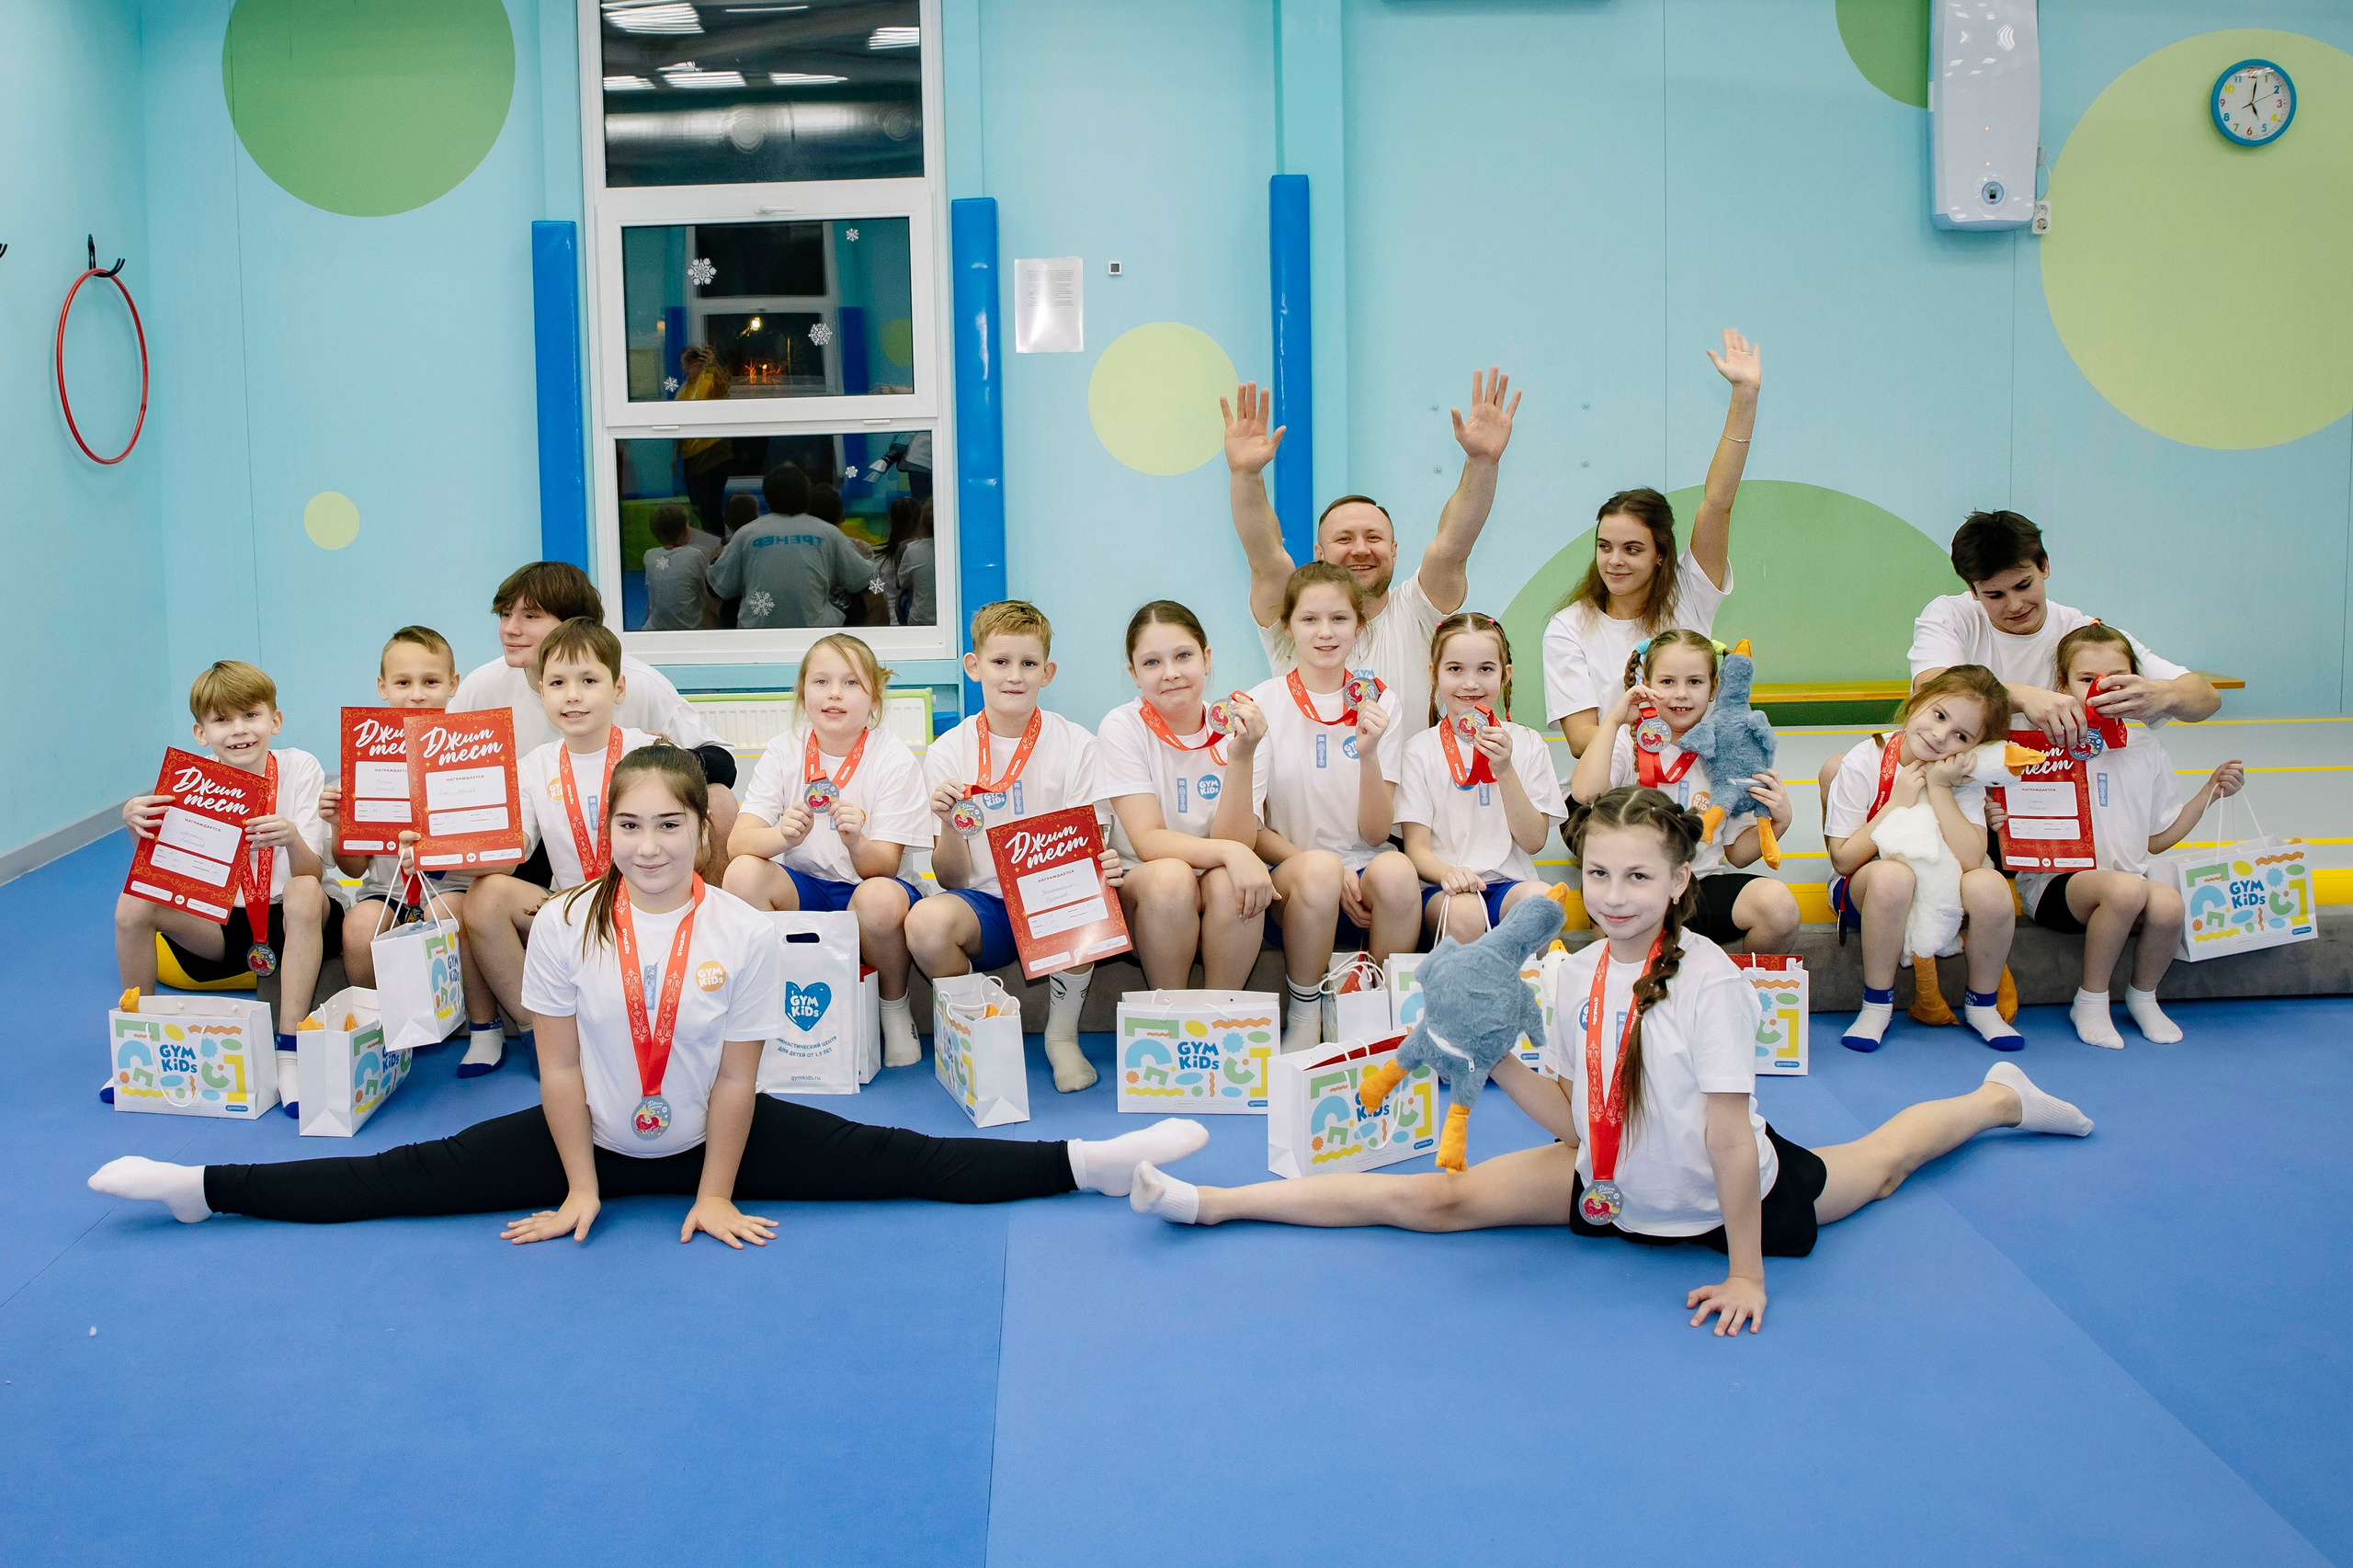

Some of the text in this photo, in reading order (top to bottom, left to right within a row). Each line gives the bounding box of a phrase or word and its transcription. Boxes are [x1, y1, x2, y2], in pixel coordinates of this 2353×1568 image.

[2265, 74, 2268, 83] 1
[2224, 85, 2234, 94] 10
[2274, 85, 2279, 94] 2
[2220, 98, 2225, 108] 9
[2277, 99, 2282, 108] 3
[2223, 113, 2230, 121] 8
[2270, 113, 2278, 122] 4
[2234, 123, 2239, 131] 7
[2246, 127, 2252, 135] 6
[2261, 123, 2268, 132] 5
[353, 718, 405, 748] Джи
[369, 741, 407, 756] тес
[419, 726, 494, 758] Джим
[438, 742, 504, 766] тест
[173, 767, 246, 799] Джим
[1199, 779, 1219, 788] GYM
[184, 793, 250, 815] тест
[185, 818, 222, 833] НАГРАЖДАЕТСЯ
[1005, 825, 1077, 864] Джим
[1027, 835, 1089, 869] тест
[1038, 869, 1074, 883] НАГРАЖДАЕТСЯ
[2229, 879, 2265, 895] GYM
[447, 954, 459, 970] GYM
[697, 966, 722, 979] GYM
[790, 994, 819, 1007] GYM
[776, 1035, 837, 1050] ИМНАСТИЧЕСКИЙ ЦЕНТР
[1176, 1041, 1220, 1056] GYM
[159, 1044, 197, 1061] GYM
[778, 1046, 789, 1054] ДЛЯ
[1356, 1105, 1390, 1122] KDs
